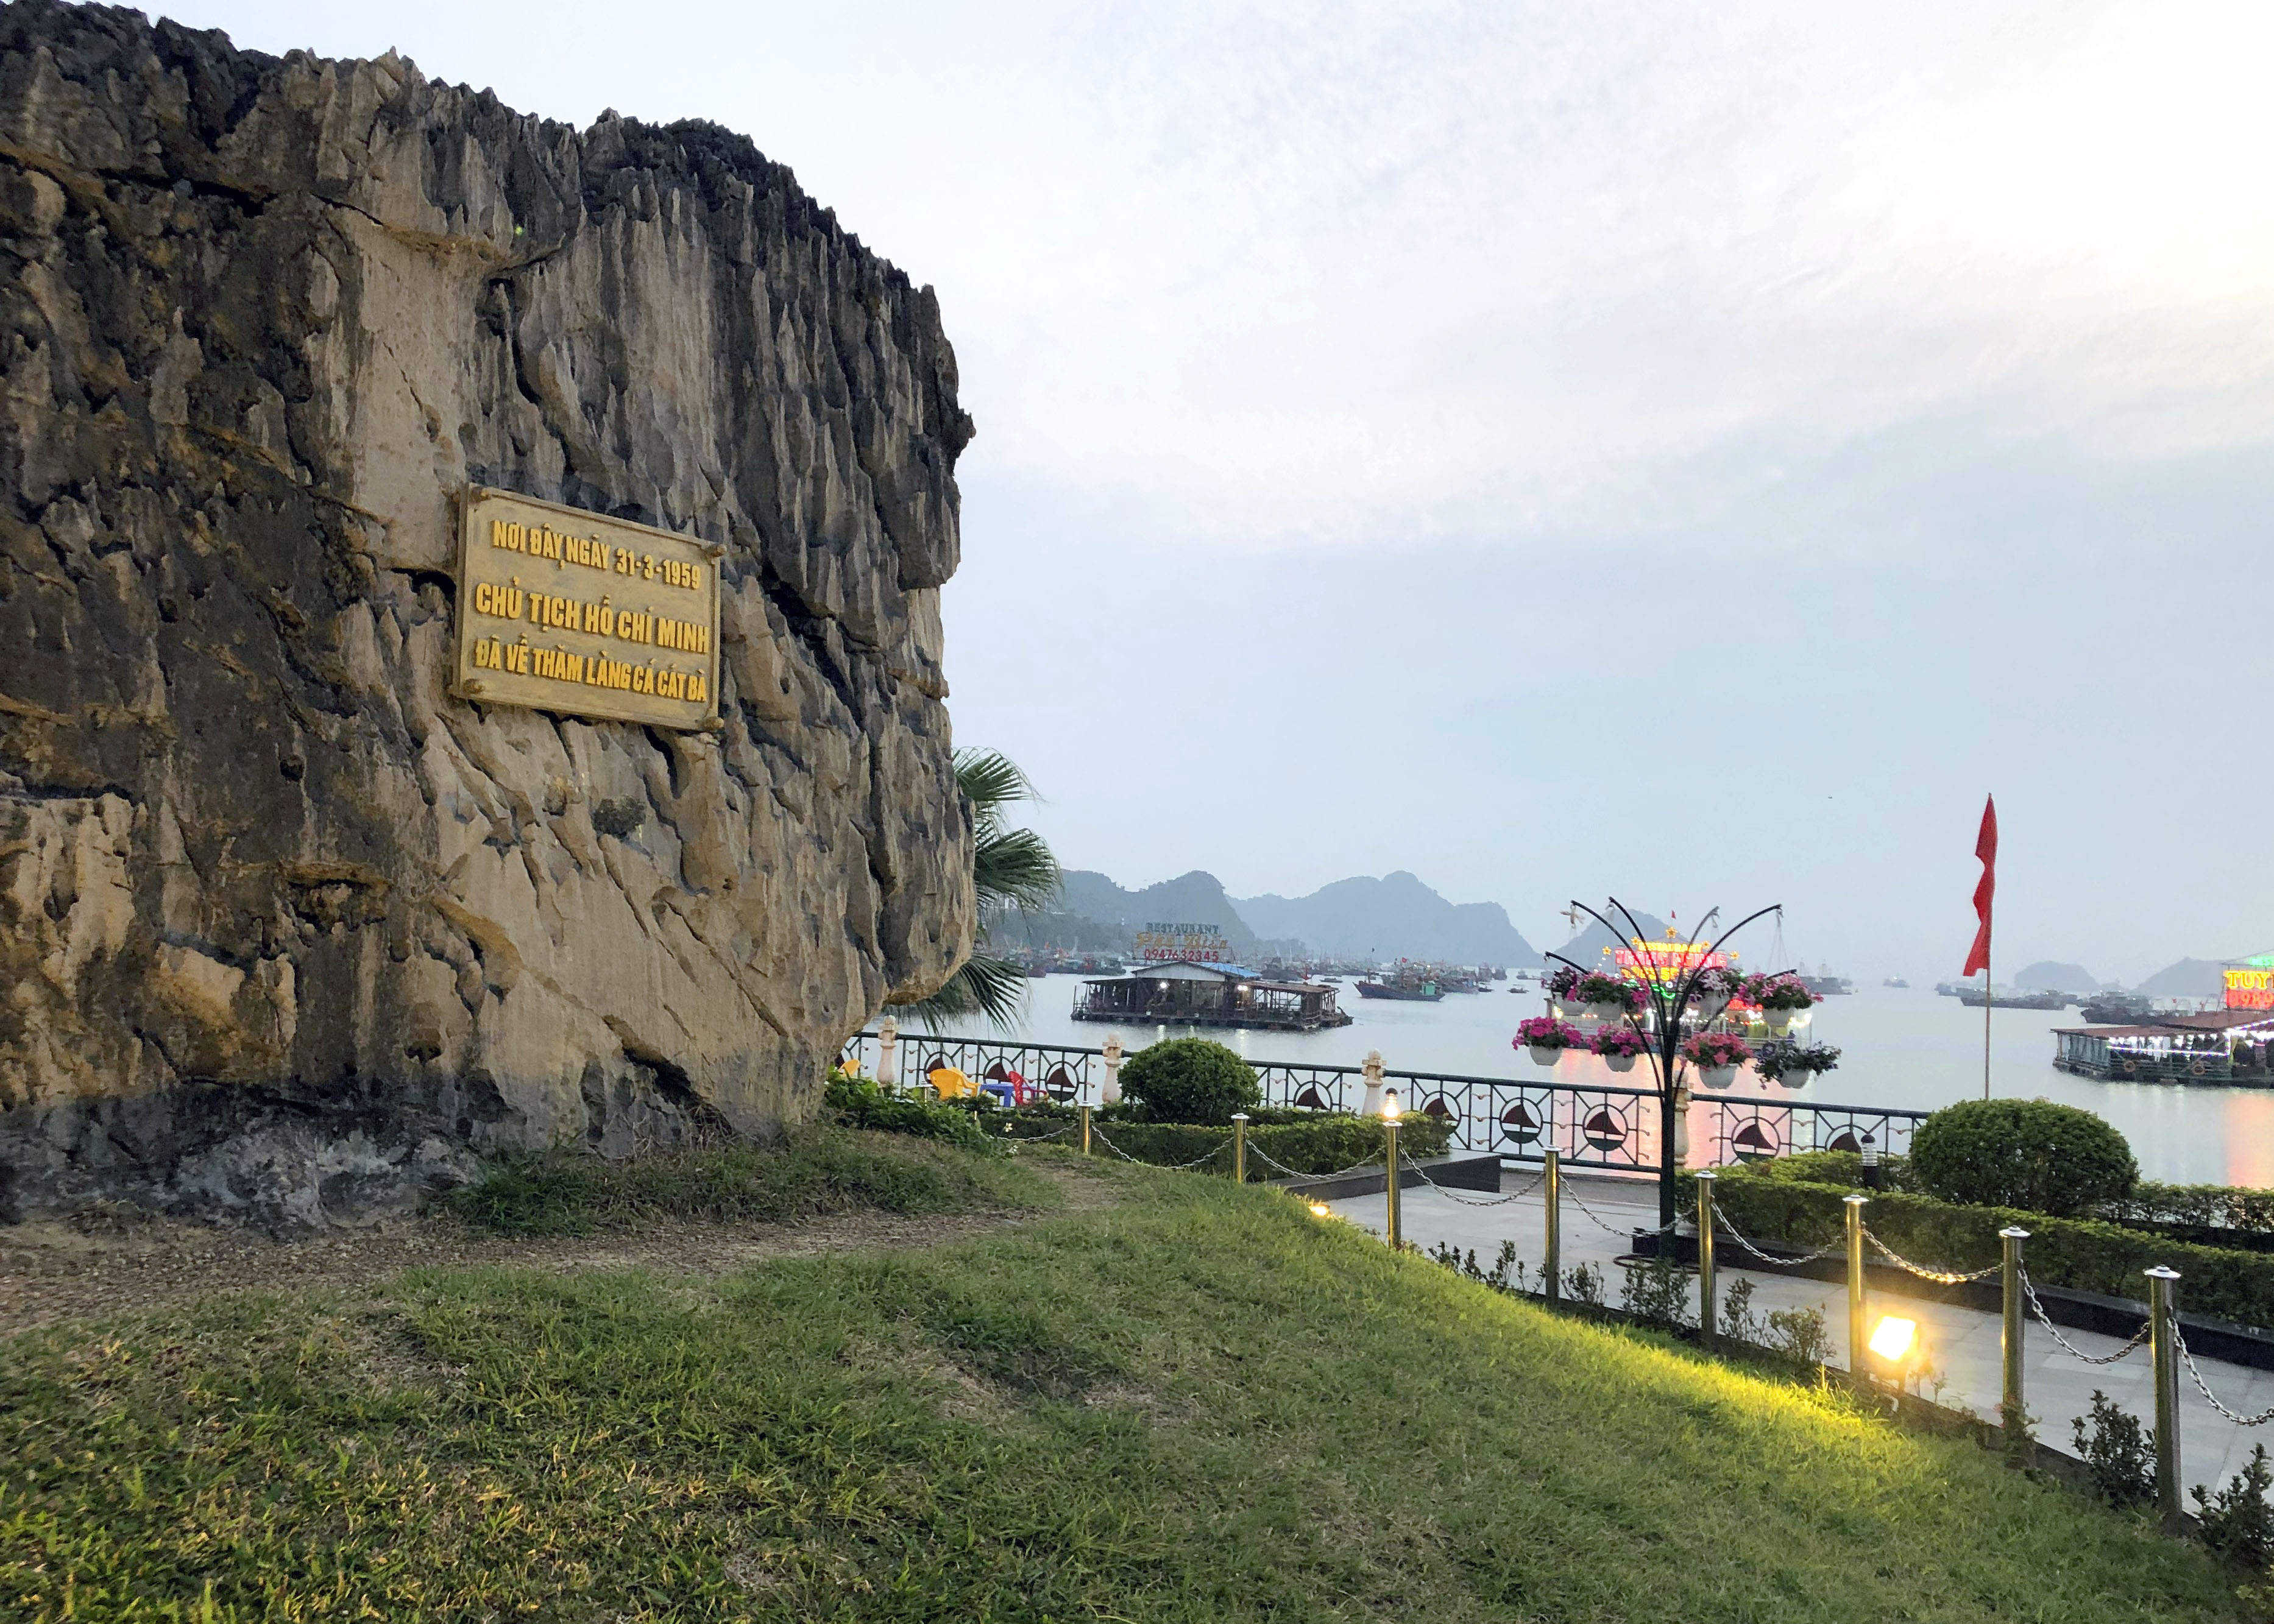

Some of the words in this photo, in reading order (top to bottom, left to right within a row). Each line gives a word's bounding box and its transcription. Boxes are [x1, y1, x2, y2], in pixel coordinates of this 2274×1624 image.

[492, 520, 525, 551] NƠI
[565, 534, 610, 569] NGÀY
[476, 576, 522, 620] CHỦ
[530, 593, 580, 632] TỊCH
[585, 594, 614, 635] HỒ
[618, 606, 652, 643] CHÍ
[657, 617, 709, 653] MINH
[475, 634, 501, 669] ĐÃ
[507, 632, 529, 674] VỀ
[533, 643, 583, 682] THĂM
[586, 650, 631, 689] LÀNG
[633, 658, 654, 694] CÁ
[657, 663, 686, 698] CÁT
[688, 669, 707, 702] BÀ
[1146, 922, 1219, 934] RESTAURANT
[2223, 970, 2274, 989] TUY
